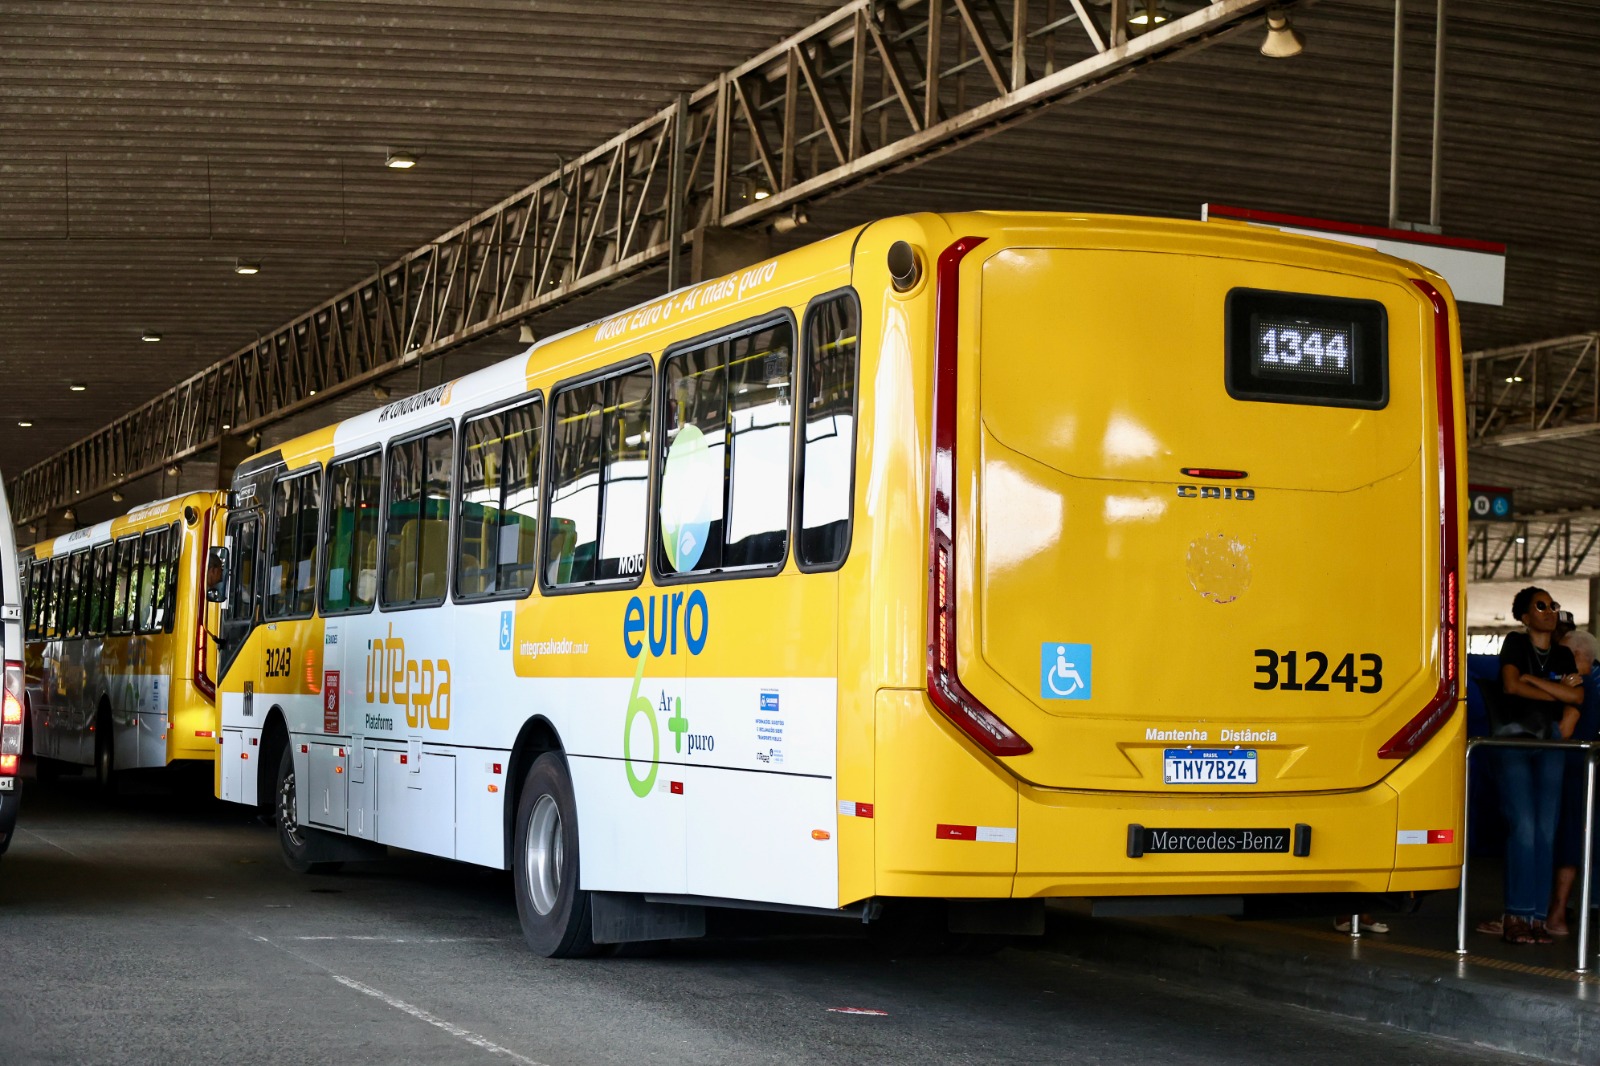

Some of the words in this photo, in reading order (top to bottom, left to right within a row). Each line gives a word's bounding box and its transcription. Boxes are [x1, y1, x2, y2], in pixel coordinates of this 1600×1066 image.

[594, 313, 633, 343] Motor
[630, 303, 663, 330] Euro
[663, 296, 677, 320] 6
[680, 288, 703, 313] Ar
[700, 274, 738, 306] mais
[738, 261, 777, 300] puro
[1263, 329, 1347, 368] 1344
[1177, 485, 1255, 501] CAIO
[623, 589, 708, 659] euro
[266, 647, 291, 677] 31243
[1253, 649, 1383, 694] 31243
[366, 713, 393, 731] Plataforma
[624, 622, 659, 798] 6
[659, 689, 672, 711] Ar
[688, 733, 714, 755] puro
[1145, 728, 1208, 741] Mantenha
[1220, 727, 1277, 742] Distância
[1173, 760, 1247, 780] TMY7B24
[1151, 830, 1284, 851] Mercedes-Benz
